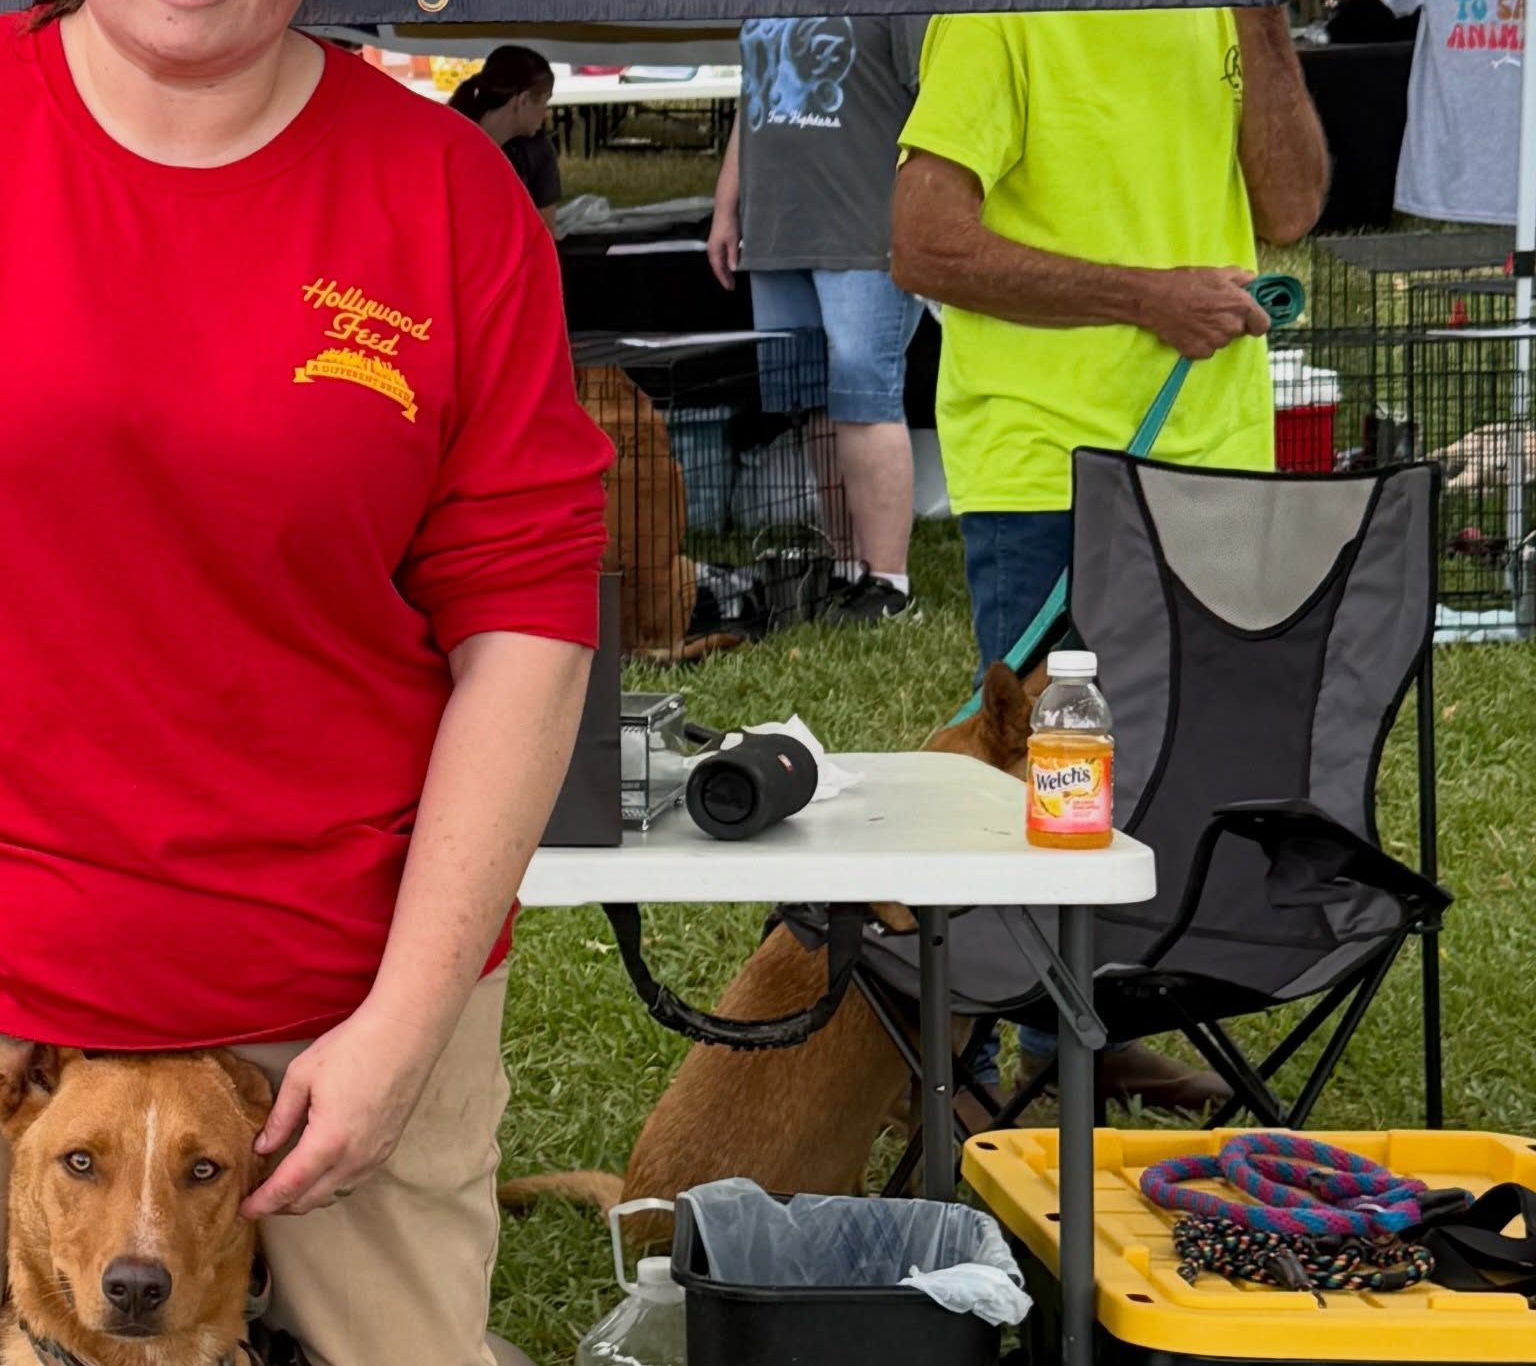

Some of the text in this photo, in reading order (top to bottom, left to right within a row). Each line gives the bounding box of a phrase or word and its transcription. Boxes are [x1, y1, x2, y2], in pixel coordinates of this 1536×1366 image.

[302, 277, 432, 341] Hollywood
[324, 313, 400, 355] Feed
[1036, 766, 1091, 791] Welch's
